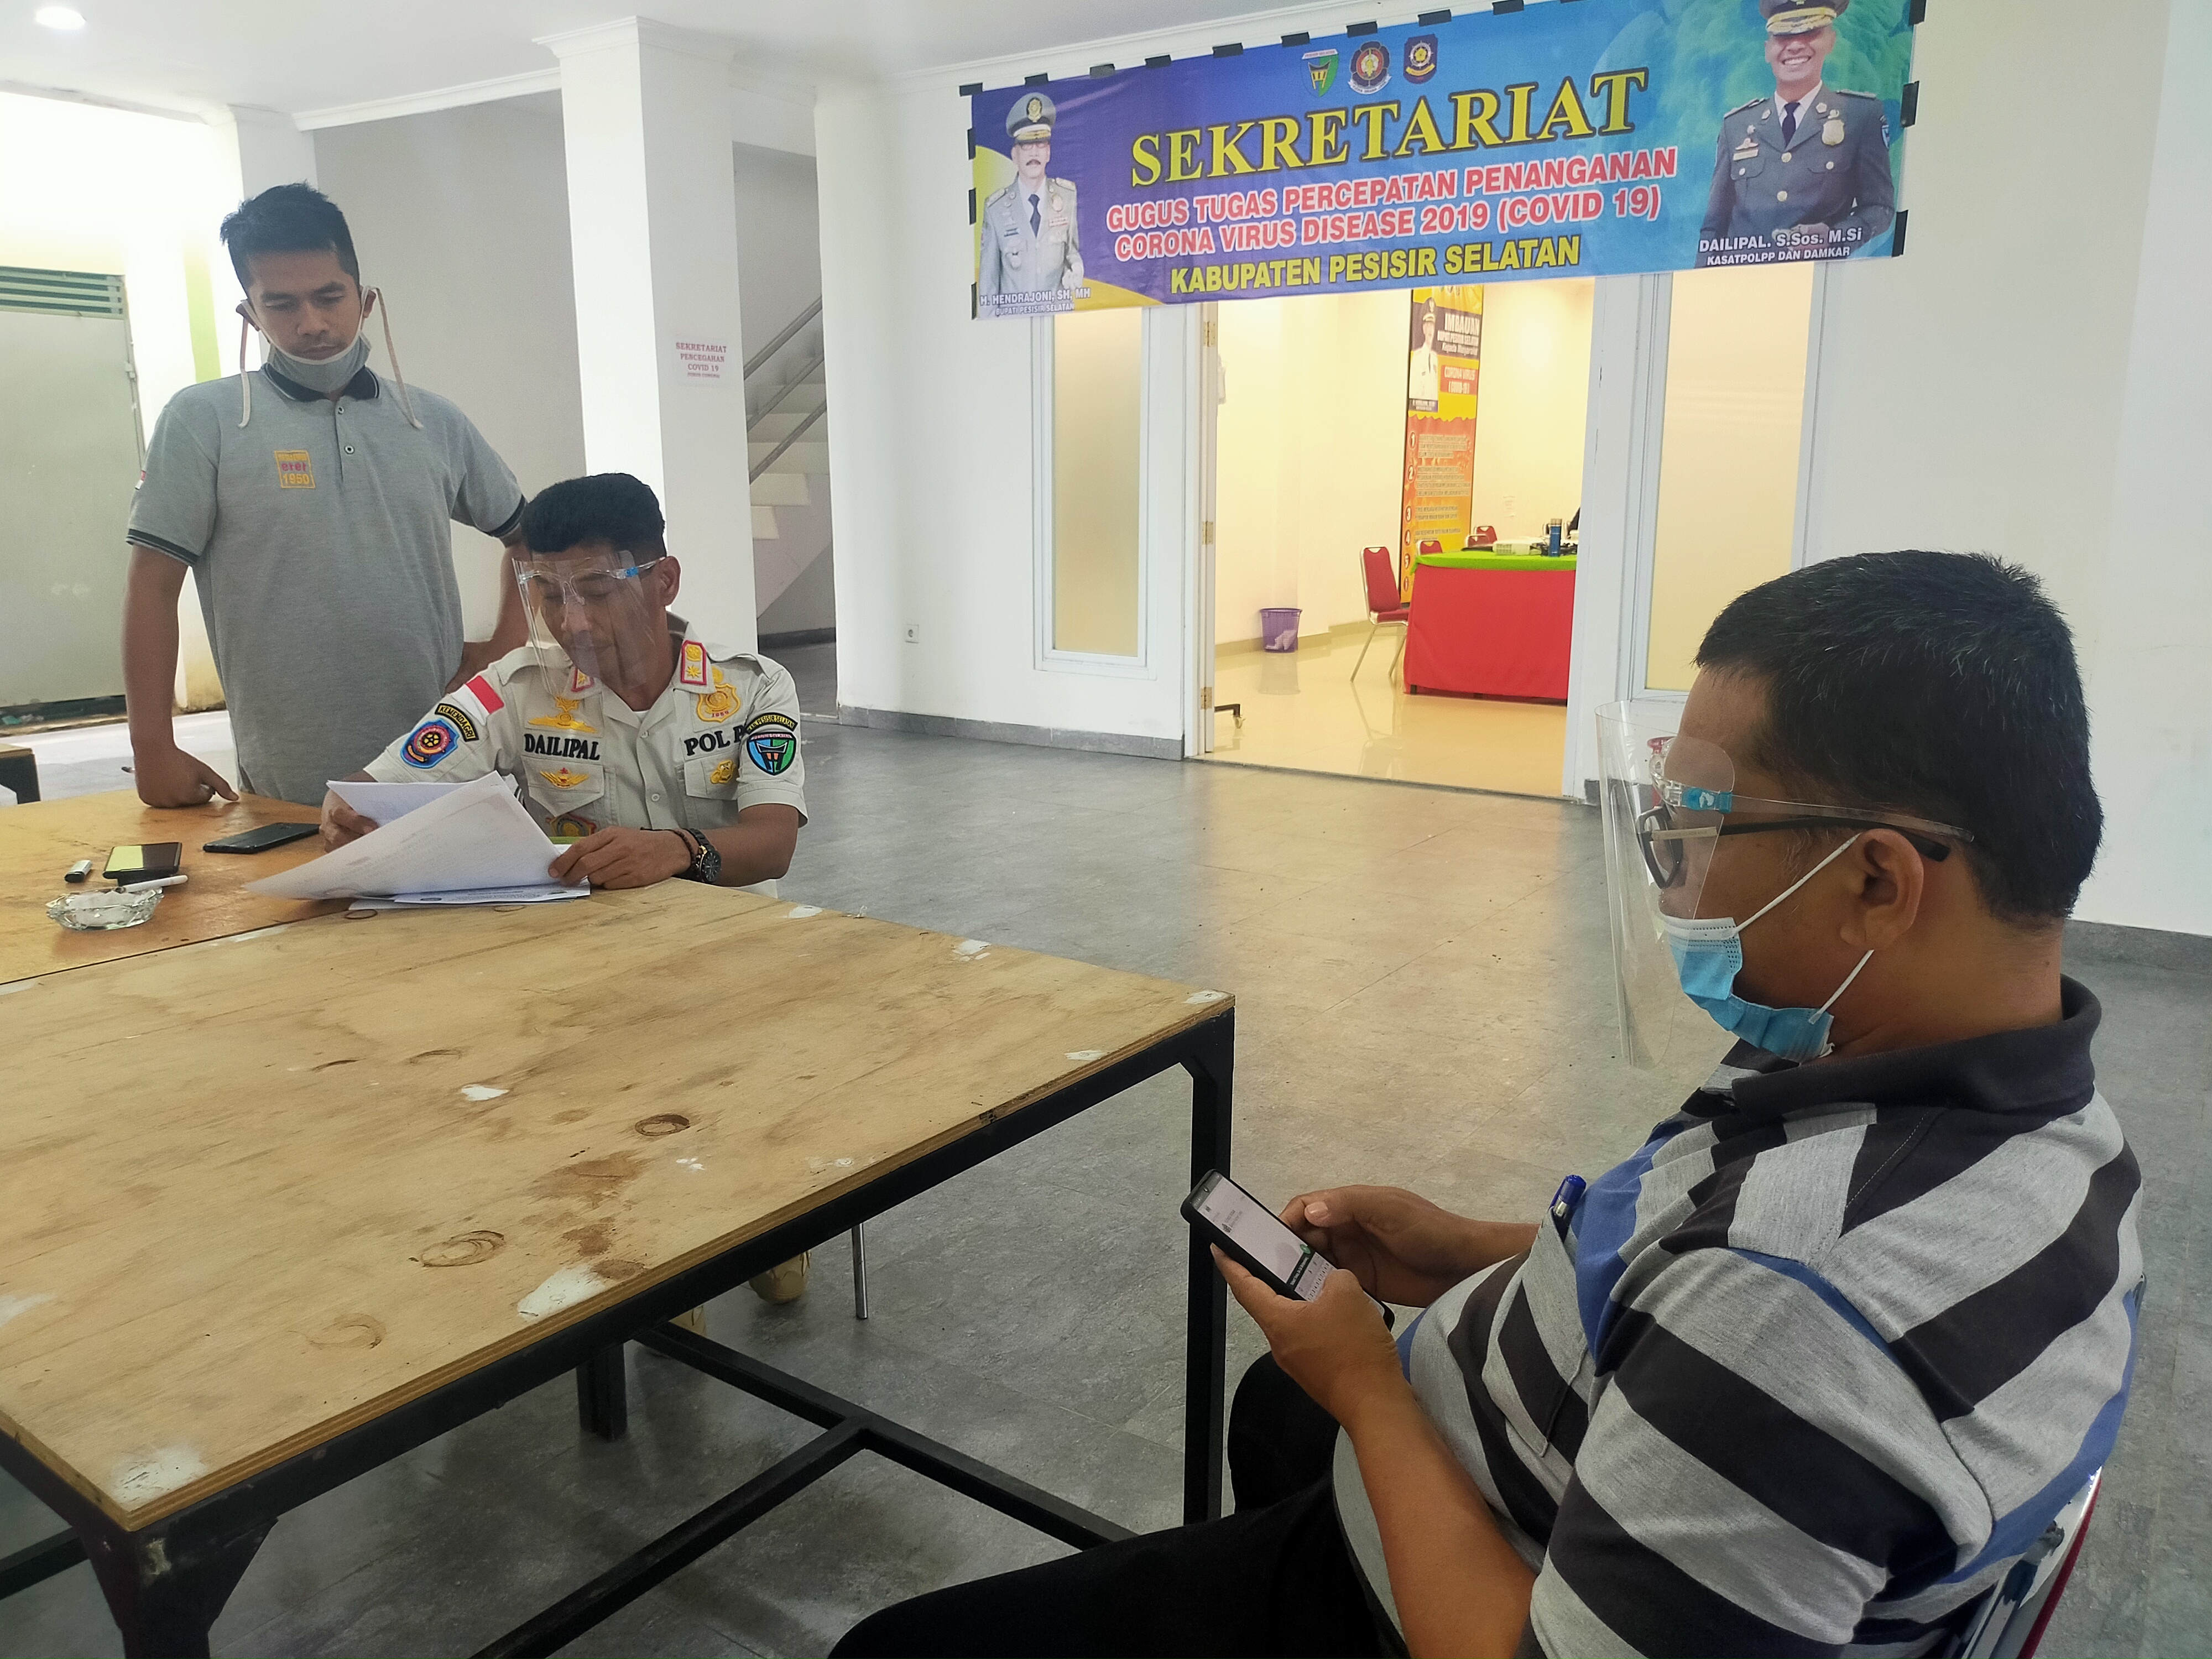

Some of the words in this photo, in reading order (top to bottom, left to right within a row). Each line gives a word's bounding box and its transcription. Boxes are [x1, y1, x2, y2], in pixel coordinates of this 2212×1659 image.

[1130, 67, 1648, 187] SEKRETARIAT
[1107, 199, 1188, 232] GUGUS
[1194, 189, 1277, 223] TUGAS
[1283, 169, 1457, 215] PERCEPATAN
[1464, 147, 1677, 197] PENANGANAN
[1115, 227, 1215, 262] CORONA
[1220, 219, 1296, 252] VIRUS
[1302, 208, 1415, 245] DISEASE
[1420, 201, 1490, 234] 2019
[1498, 190, 1603, 233] (COVID
[1613, 184, 1661, 221] 19)
[1698, 236, 1771, 252] DAILIPAL.
[1776, 233, 1823, 247] S.Sos.
[1828, 228, 1862, 243] M.Si
[1170, 257, 1321, 294] KABUPATEN
[1329, 247, 1437, 283] PESISIR
[1444, 234, 1581, 274] SELATAN
[1707, 252, 1775, 265] KASATPOLPP
[1778, 250, 1801, 260] DAN
[1803, 247, 1850, 259] DAMKAR
[980, 296, 990, 306] H.
[993, 291, 1055, 305] HENDRAJONI,
[1057, 290, 1072, 301] SH,
[1076, 288, 1091, 299] MH
[995, 306, 1018, 315] BUPATI
[1020, 305, 1044, 314] PESISIR
[1046, 304, 1074, 312] SELATAN
[1444, 312, 1480, 336] IMBAUAN
[676, 342, 727, 353] SEKRETARIAT
[680, 353, 724, 362] PENCEGAHAN
[283, 473, 310, 484] 1950
[440, 706, 474, 737] KEMENDAGRI
[524, 734, 600, 760] DAILIPAL
[684, 731, 731, 756] POL
